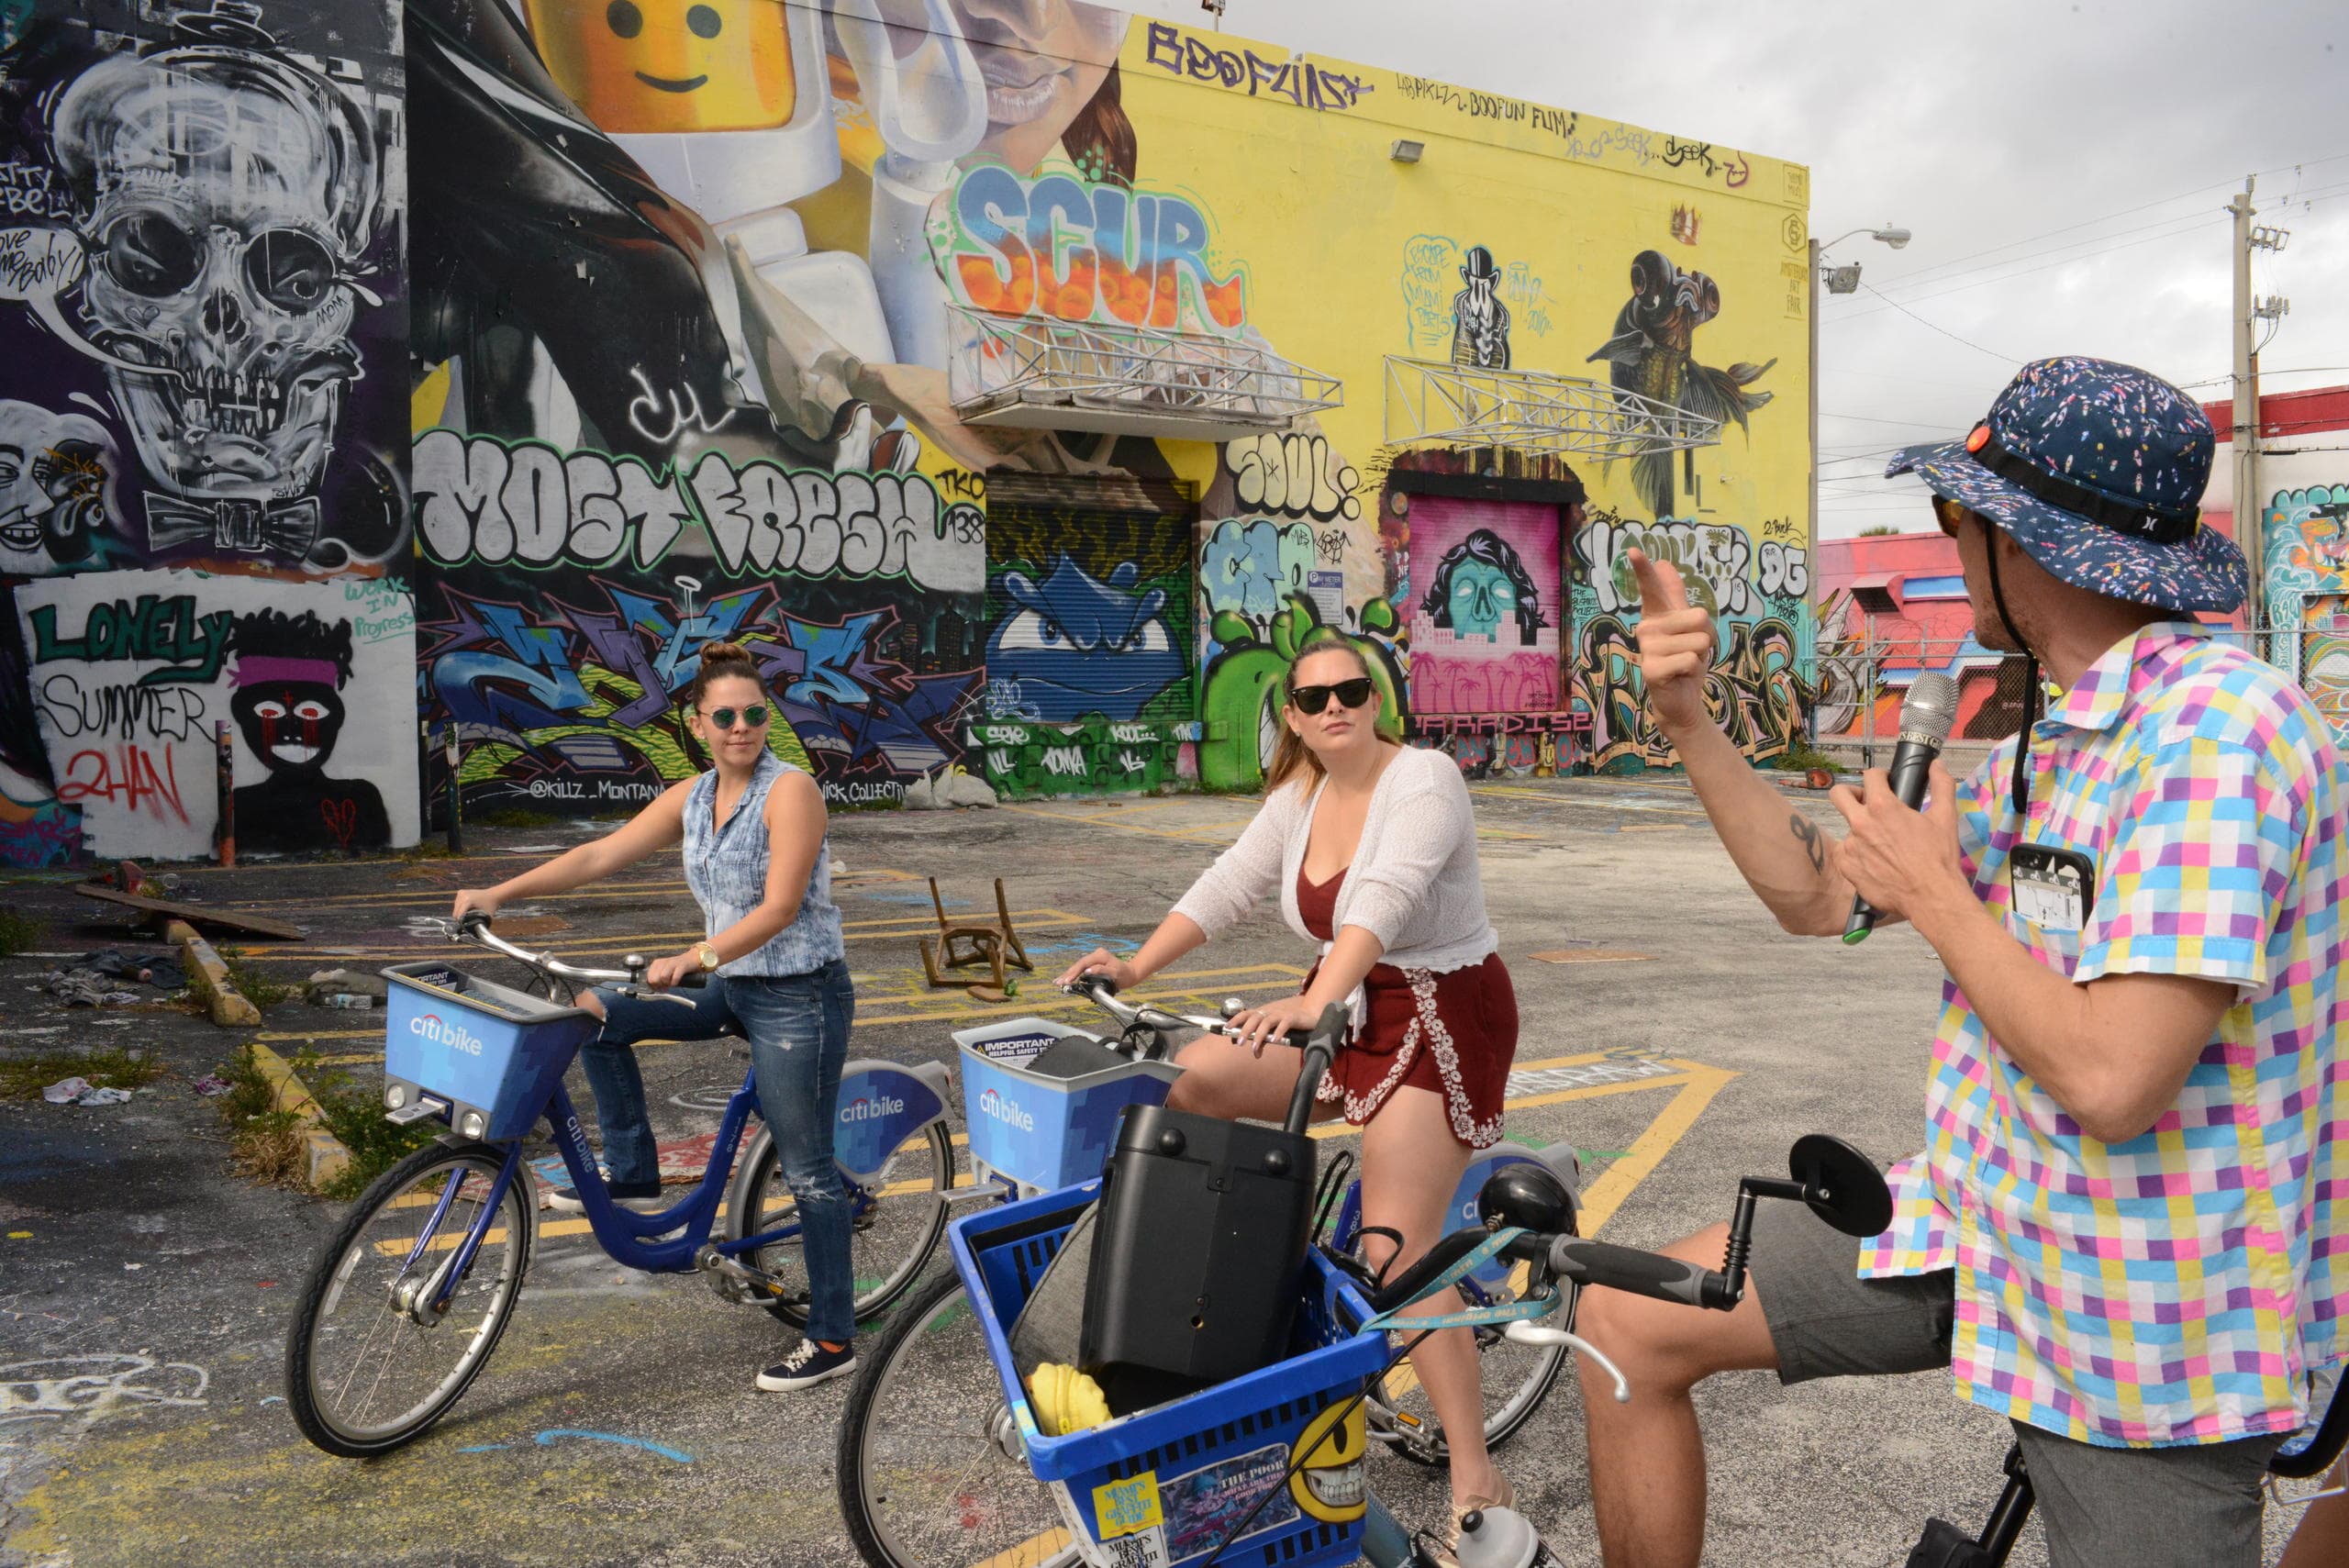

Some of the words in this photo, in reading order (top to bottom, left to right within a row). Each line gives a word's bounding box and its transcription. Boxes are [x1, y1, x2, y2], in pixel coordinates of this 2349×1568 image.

[316, 295, 350, 328] MOM
[365, 593, 398, 615] IN
[35, 674, 217, 743] SUMMER
[441, 1023, 484, 1056] bike
[985, 1038, 1054, 1051] IMPORTANT
[870, 1096, 904, 1118] bike
[1000, 1096, 1034, 1132] bike
[1221, 1473, 1247, 1488] THE
[1249, 1461, 1286, 1478] POOR
